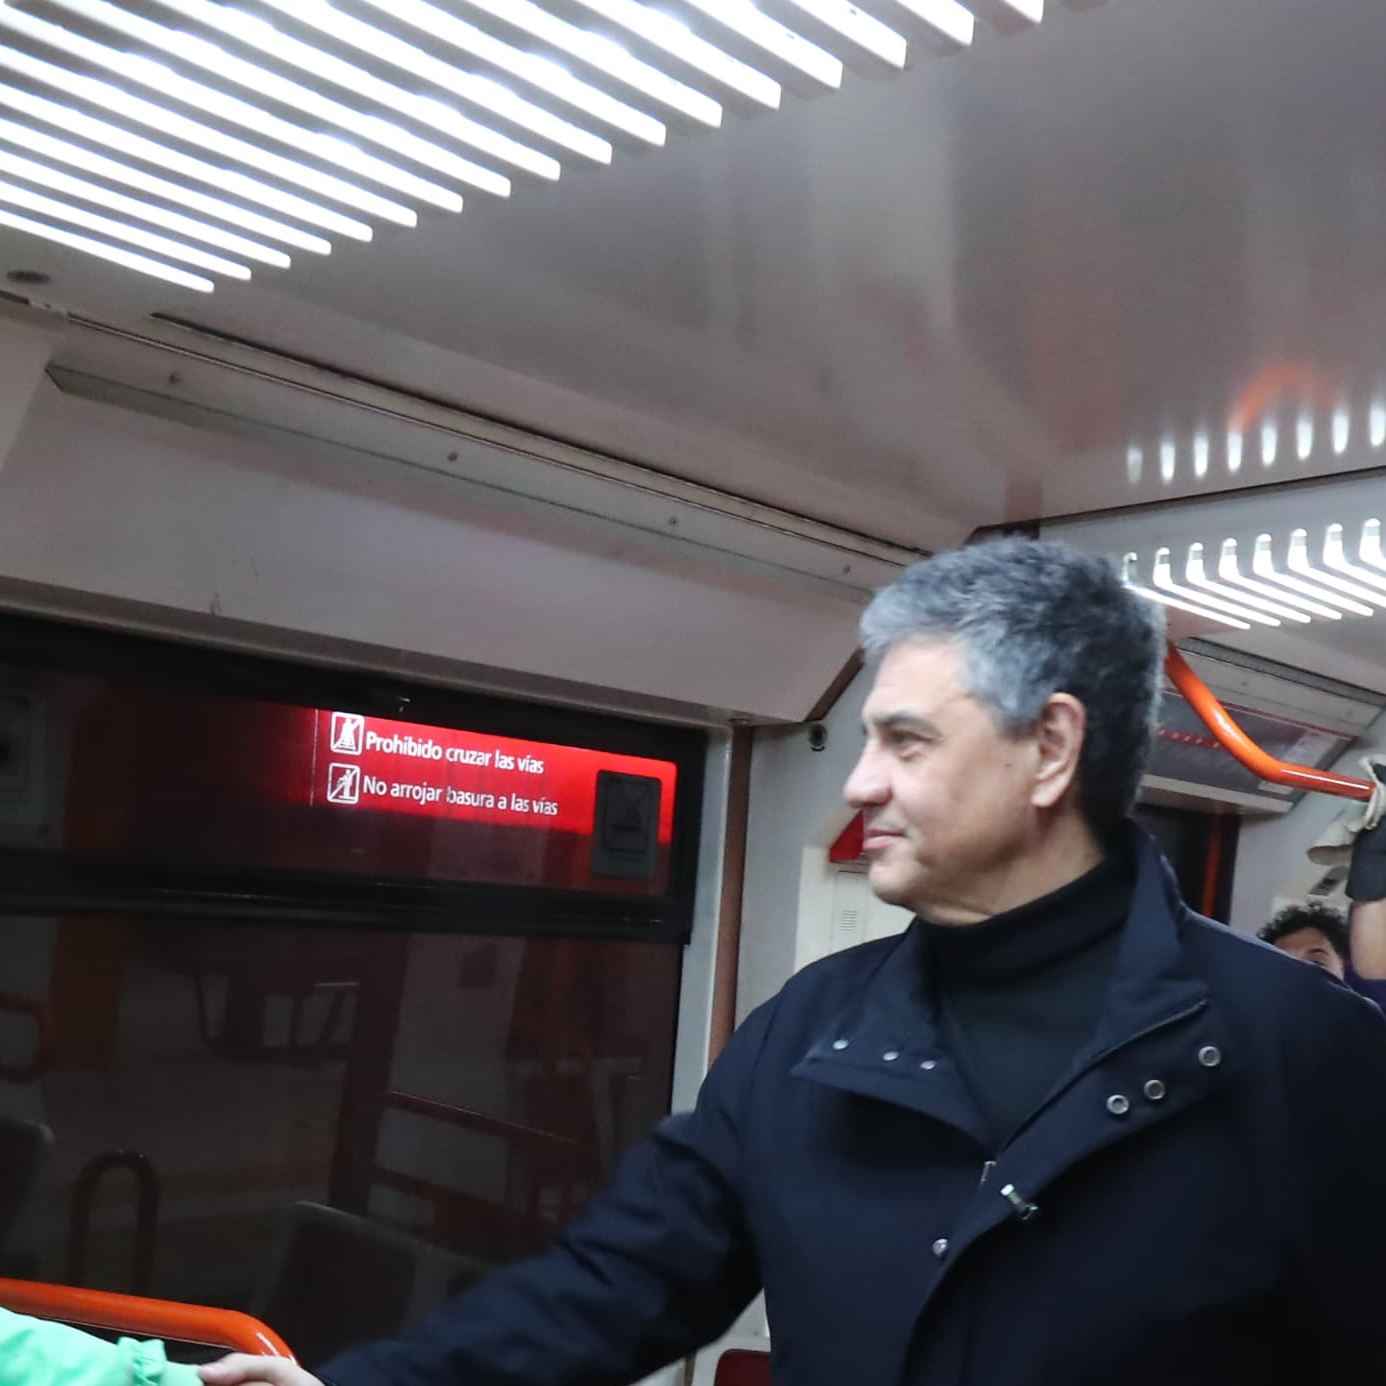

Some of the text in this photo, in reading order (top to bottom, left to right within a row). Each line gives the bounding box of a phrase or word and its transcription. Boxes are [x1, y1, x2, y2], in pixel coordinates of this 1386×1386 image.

[365, 730, 545, 774] Prohibido cruzar las vías
[363, 774, 558, 816] No arrojar basura a las vías
